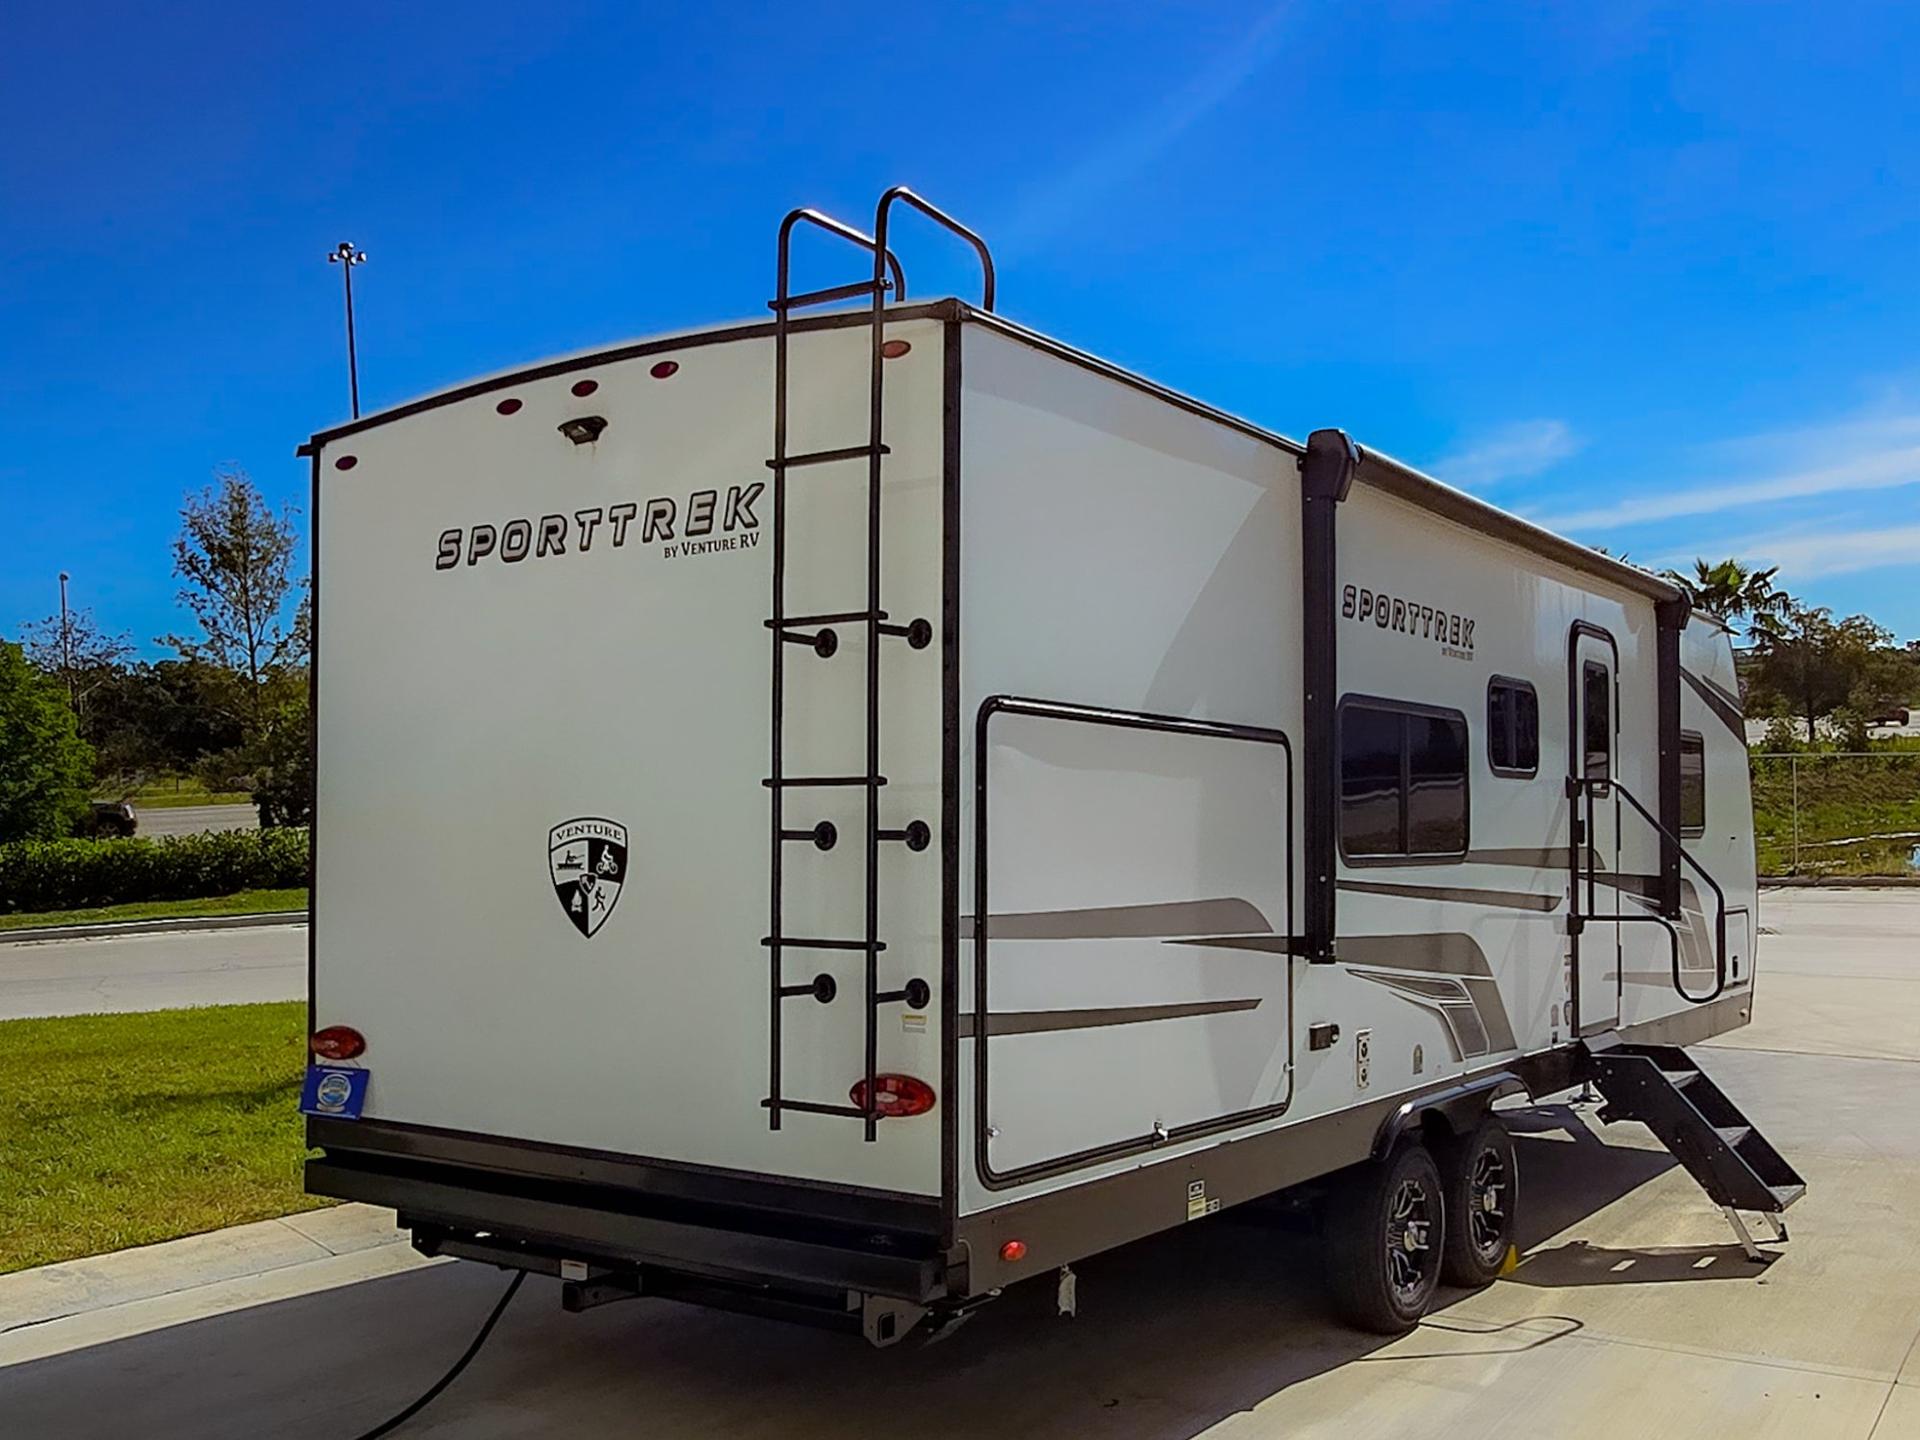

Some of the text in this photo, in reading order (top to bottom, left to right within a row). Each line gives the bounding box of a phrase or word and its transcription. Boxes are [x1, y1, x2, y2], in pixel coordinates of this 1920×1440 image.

[436, 482, 765, 570] SPORTTREK
[664, 532, 760, 559] BY VENTURE RV
[1342, 584, 1475, 650] SPORTTREK
[556, 824, 622, 840] VENTURE
